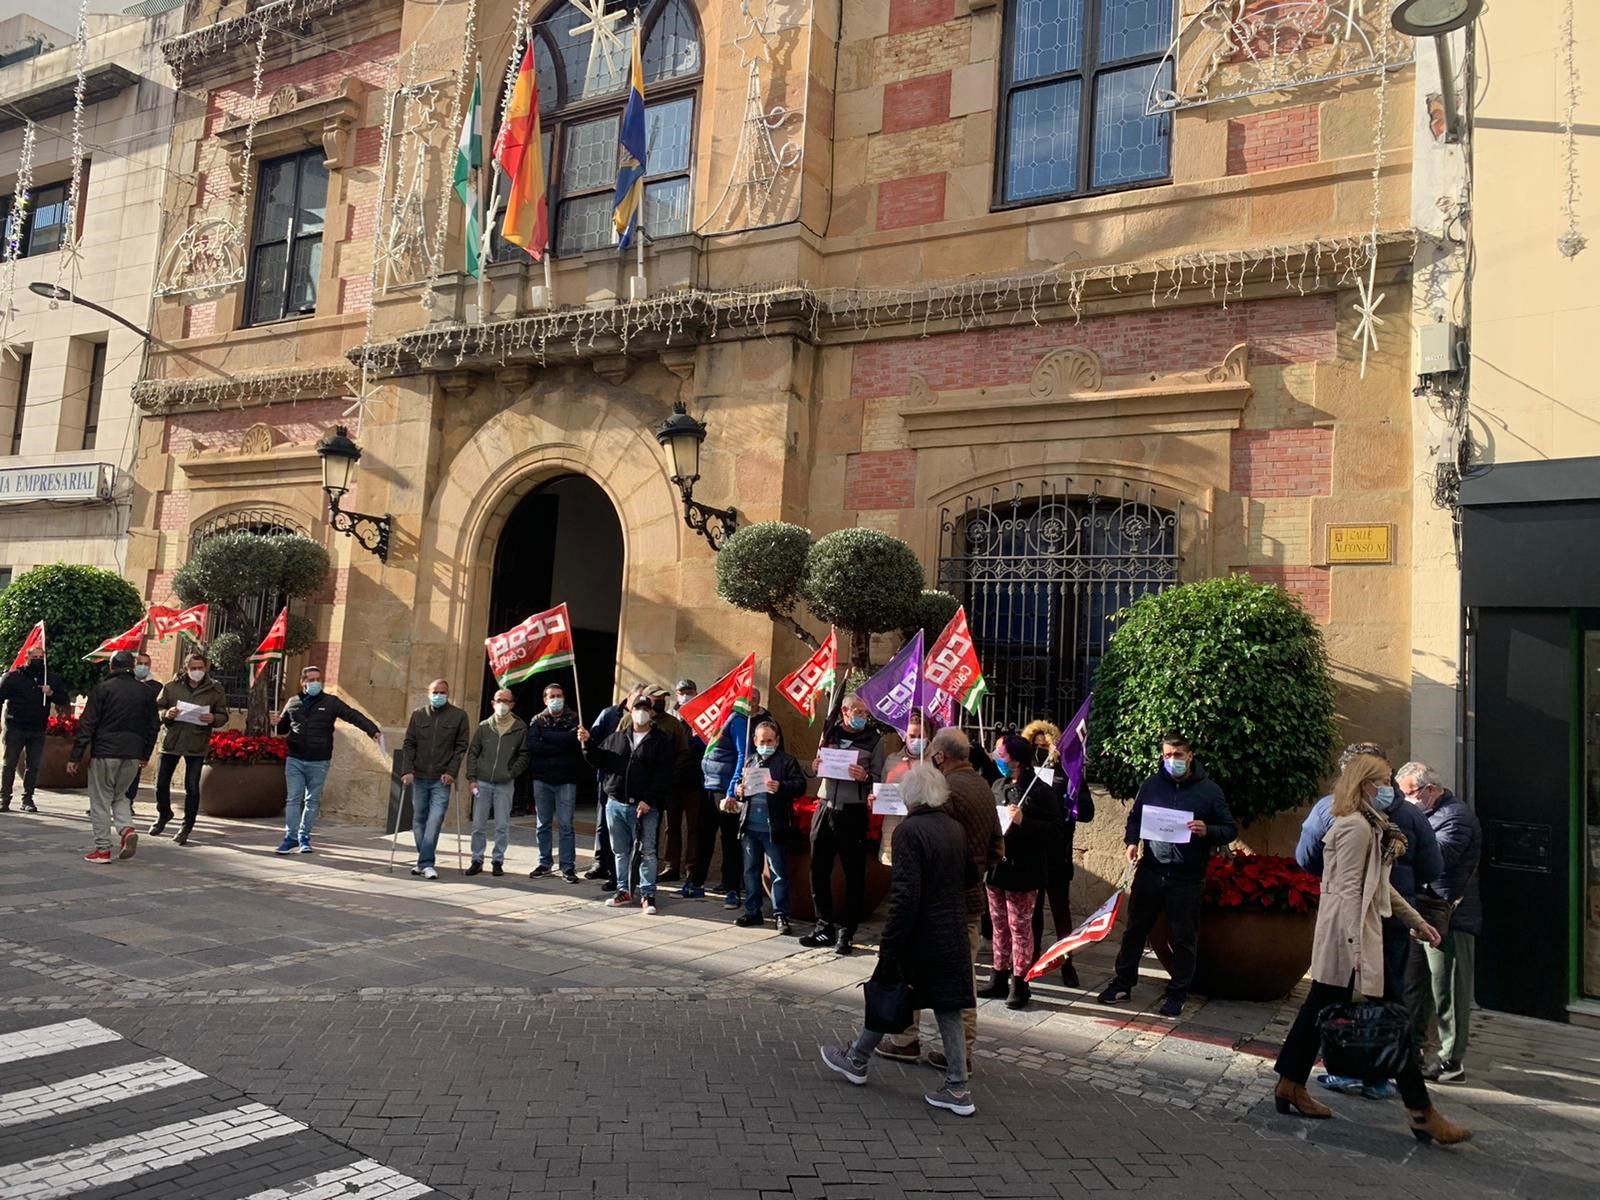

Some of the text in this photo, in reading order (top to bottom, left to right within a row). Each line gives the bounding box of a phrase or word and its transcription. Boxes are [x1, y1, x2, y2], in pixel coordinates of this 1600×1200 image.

[16, 471, 95, 492] EMPRESARIAL
[1350, 530, 1373, 540] CALLE
[1332, 543, 1374, 553] ALFONSO
